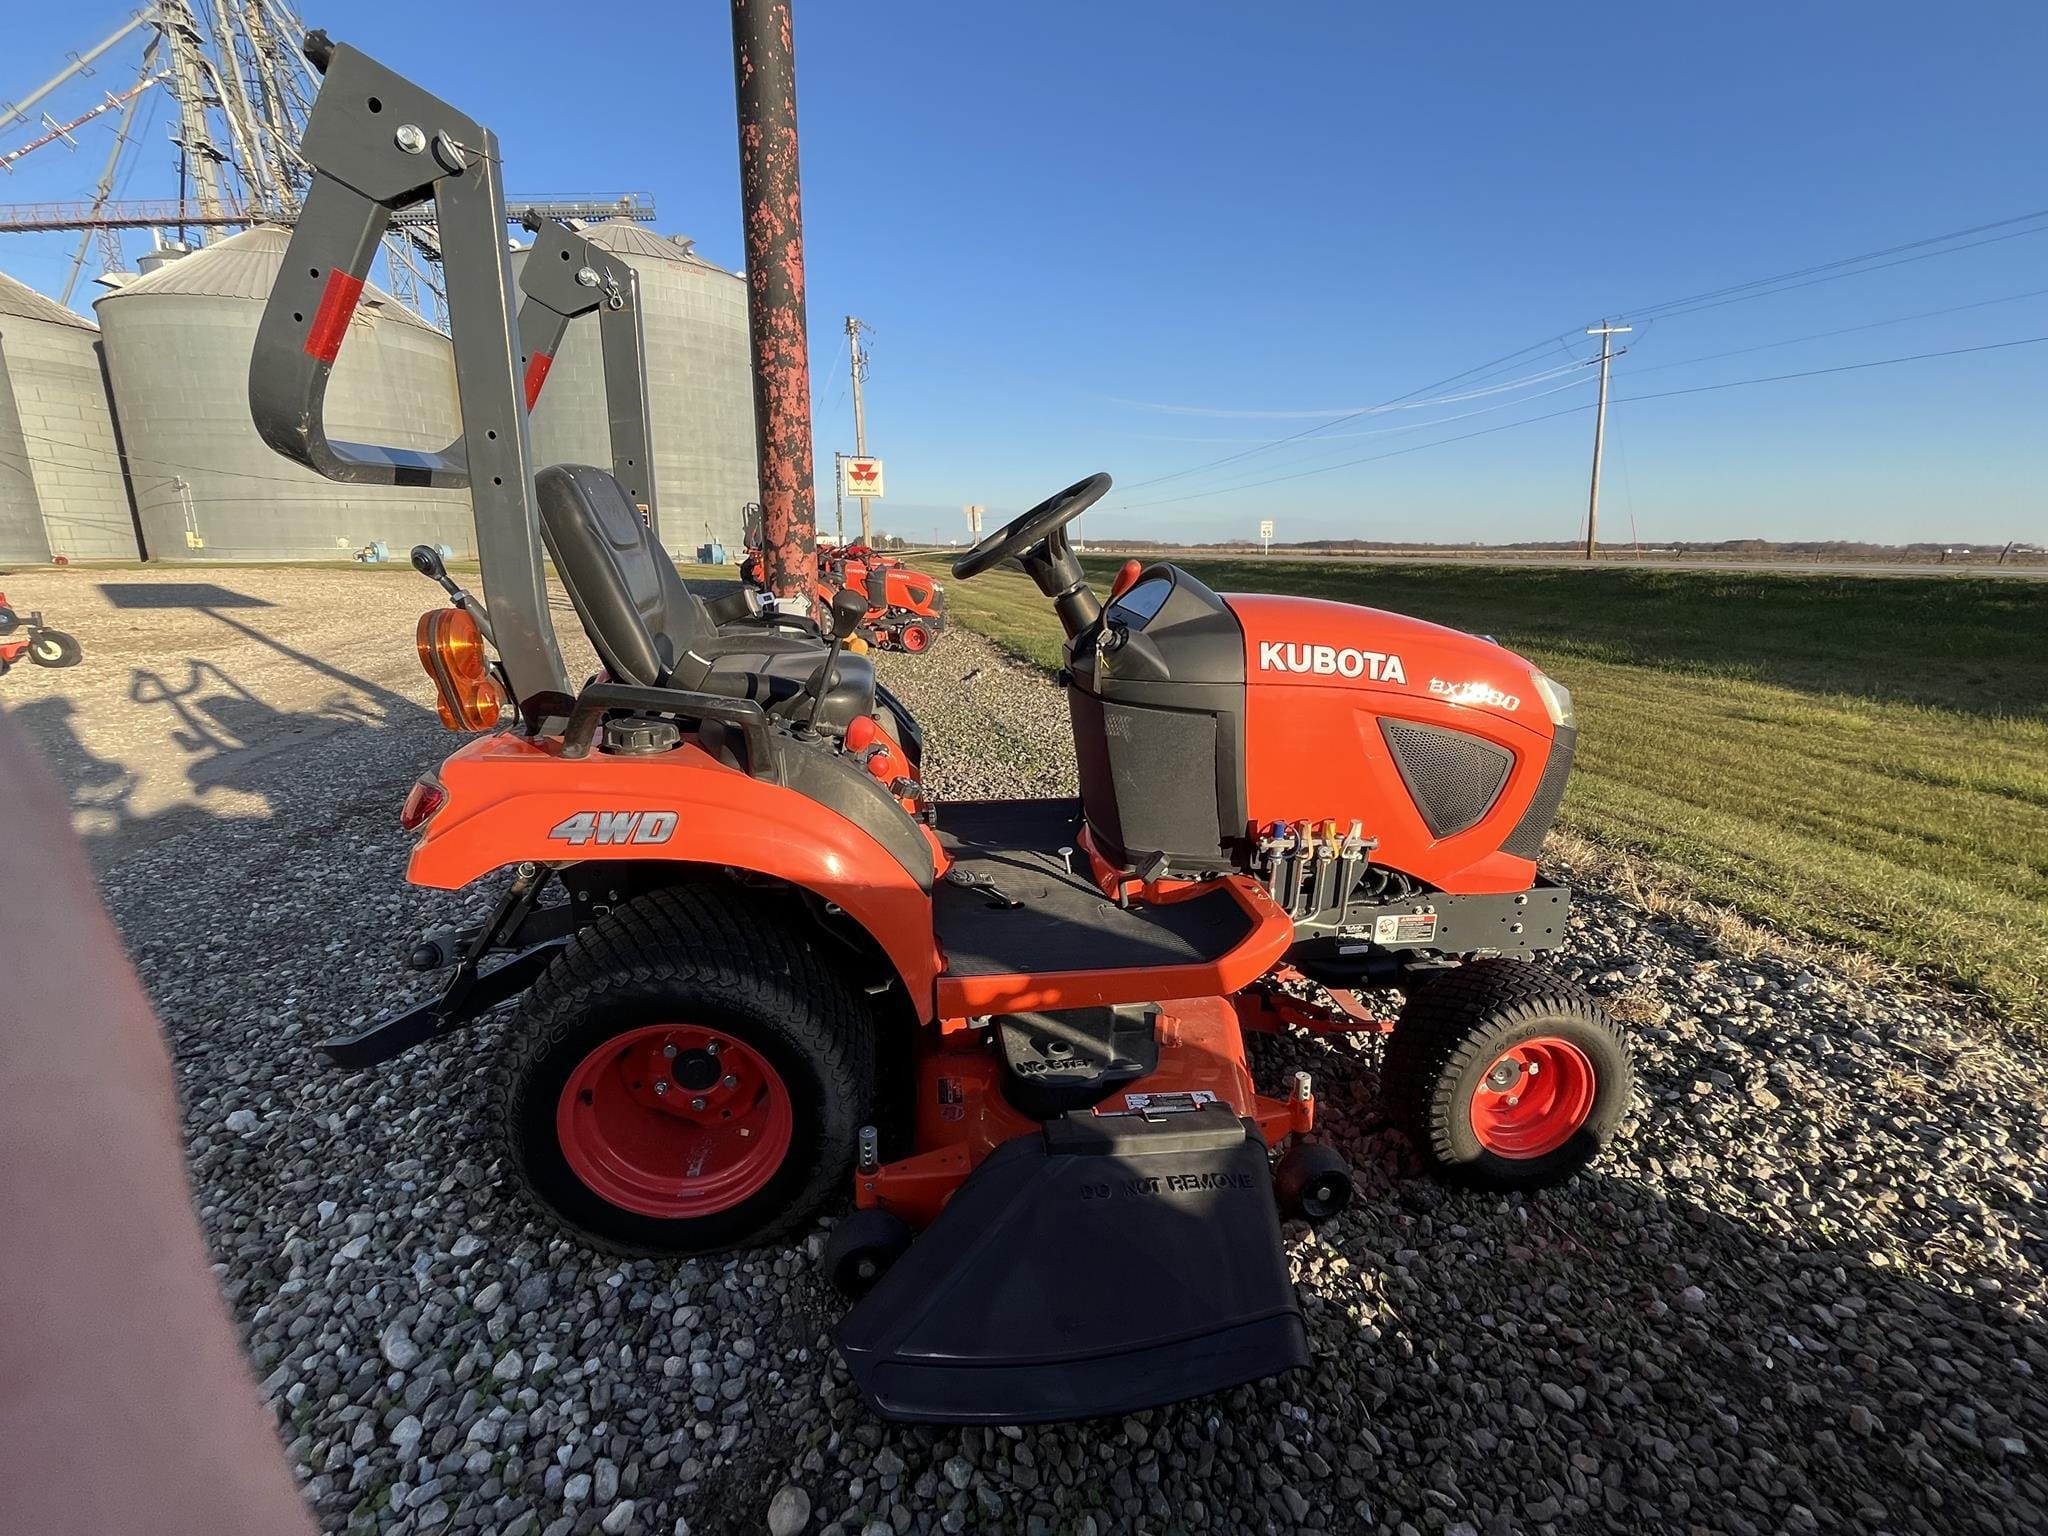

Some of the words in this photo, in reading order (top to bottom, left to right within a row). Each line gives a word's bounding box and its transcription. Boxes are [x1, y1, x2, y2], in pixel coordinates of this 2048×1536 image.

[1260, 641, 1407, 685] KUBOTA
[1428, 677, 1521, 711] BX80
[548, 811, 680, 845] 4WD
[1080, 1183, 1112, 1200] DO
[1123, 1176, 1162, 1196] NOT
[1165, 1172, 1257, 1193] REMOVE
